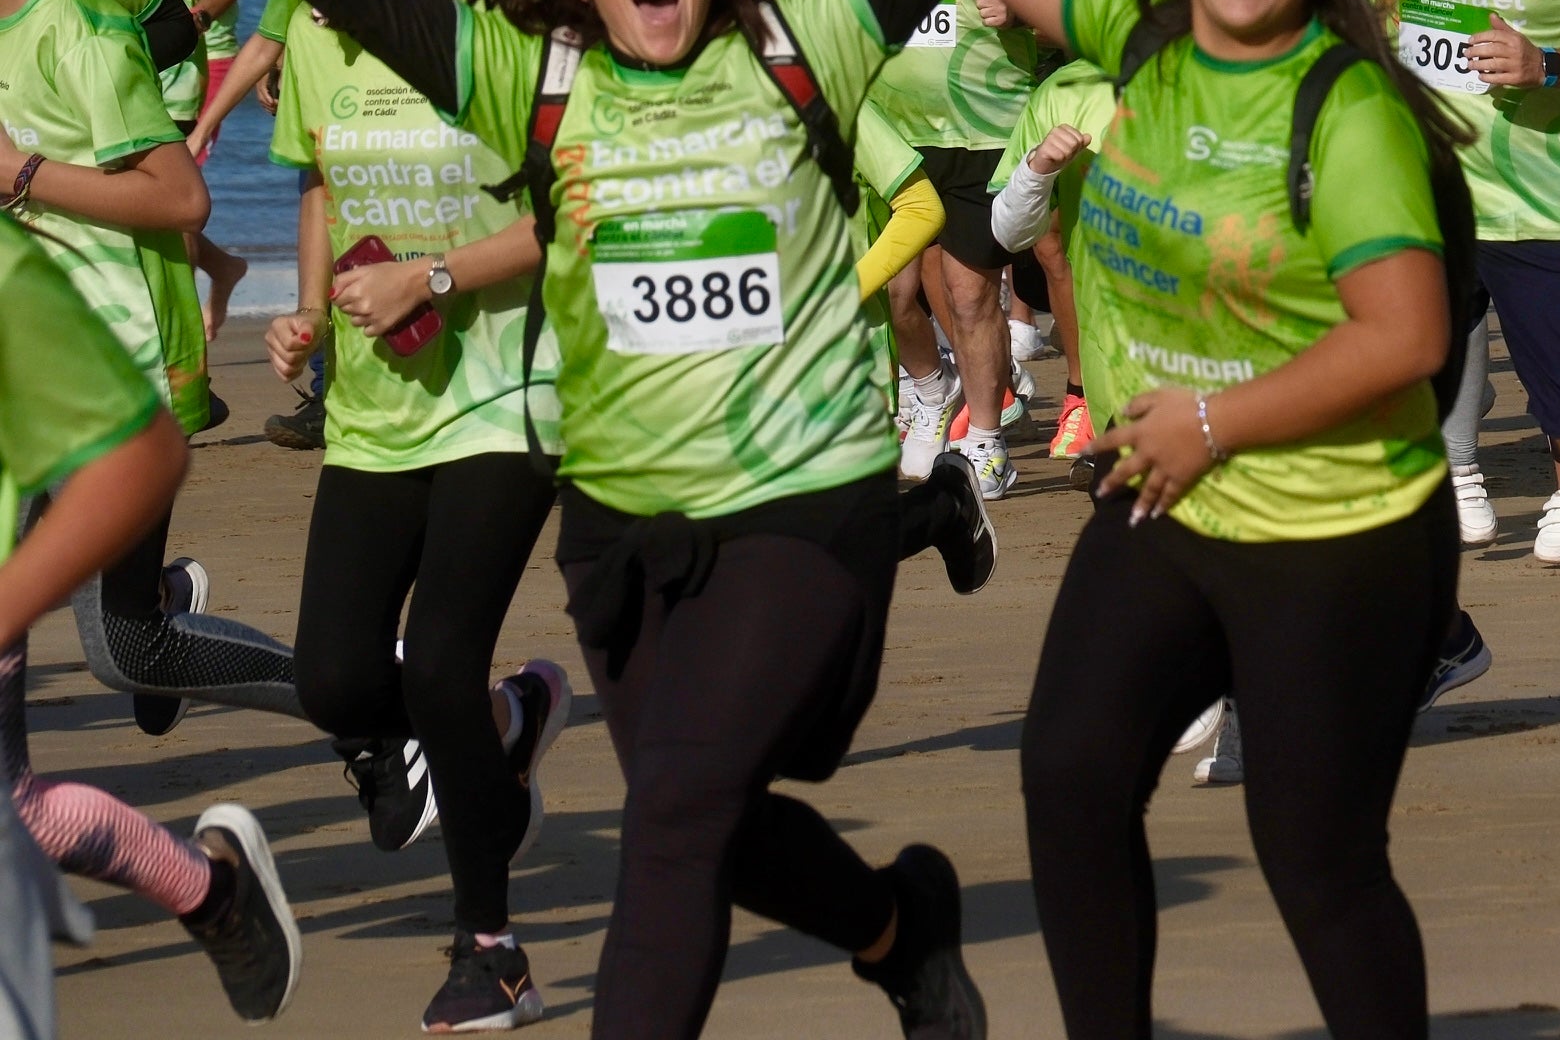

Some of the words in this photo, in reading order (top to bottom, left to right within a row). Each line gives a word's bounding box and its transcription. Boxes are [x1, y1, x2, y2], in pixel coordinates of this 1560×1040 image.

[917, 10, 950, 35] 06
[1415, 33, 1472, 74] 305
[364, 96, 390, 106] contra
[391, 96, 399, 105] el
[400, 95, 429, 105] cáncer
[366, 86, 408, 96] asociación
[362, 109, 373, 117] en
[374, 107, 397, 117] Cádiz
[324, 124, 358, 151] En
[365, 121, 479, 150] marcha
[650, 112, 787, 162] marcha
[329, 157, 435, 188] contra
[440, 154, 476, 185] el
[593, 162, 749, 209] contra
[755, 147, 791, 188] el
[340, 187, 480, 228] cáncer
[1081, 198, 1141, 248] ontra
[1100, 172, 1204, 238] marcha
[632, 266, 771, 323] 3886
[1128, 337, 1255, 382] HYUNDAI
